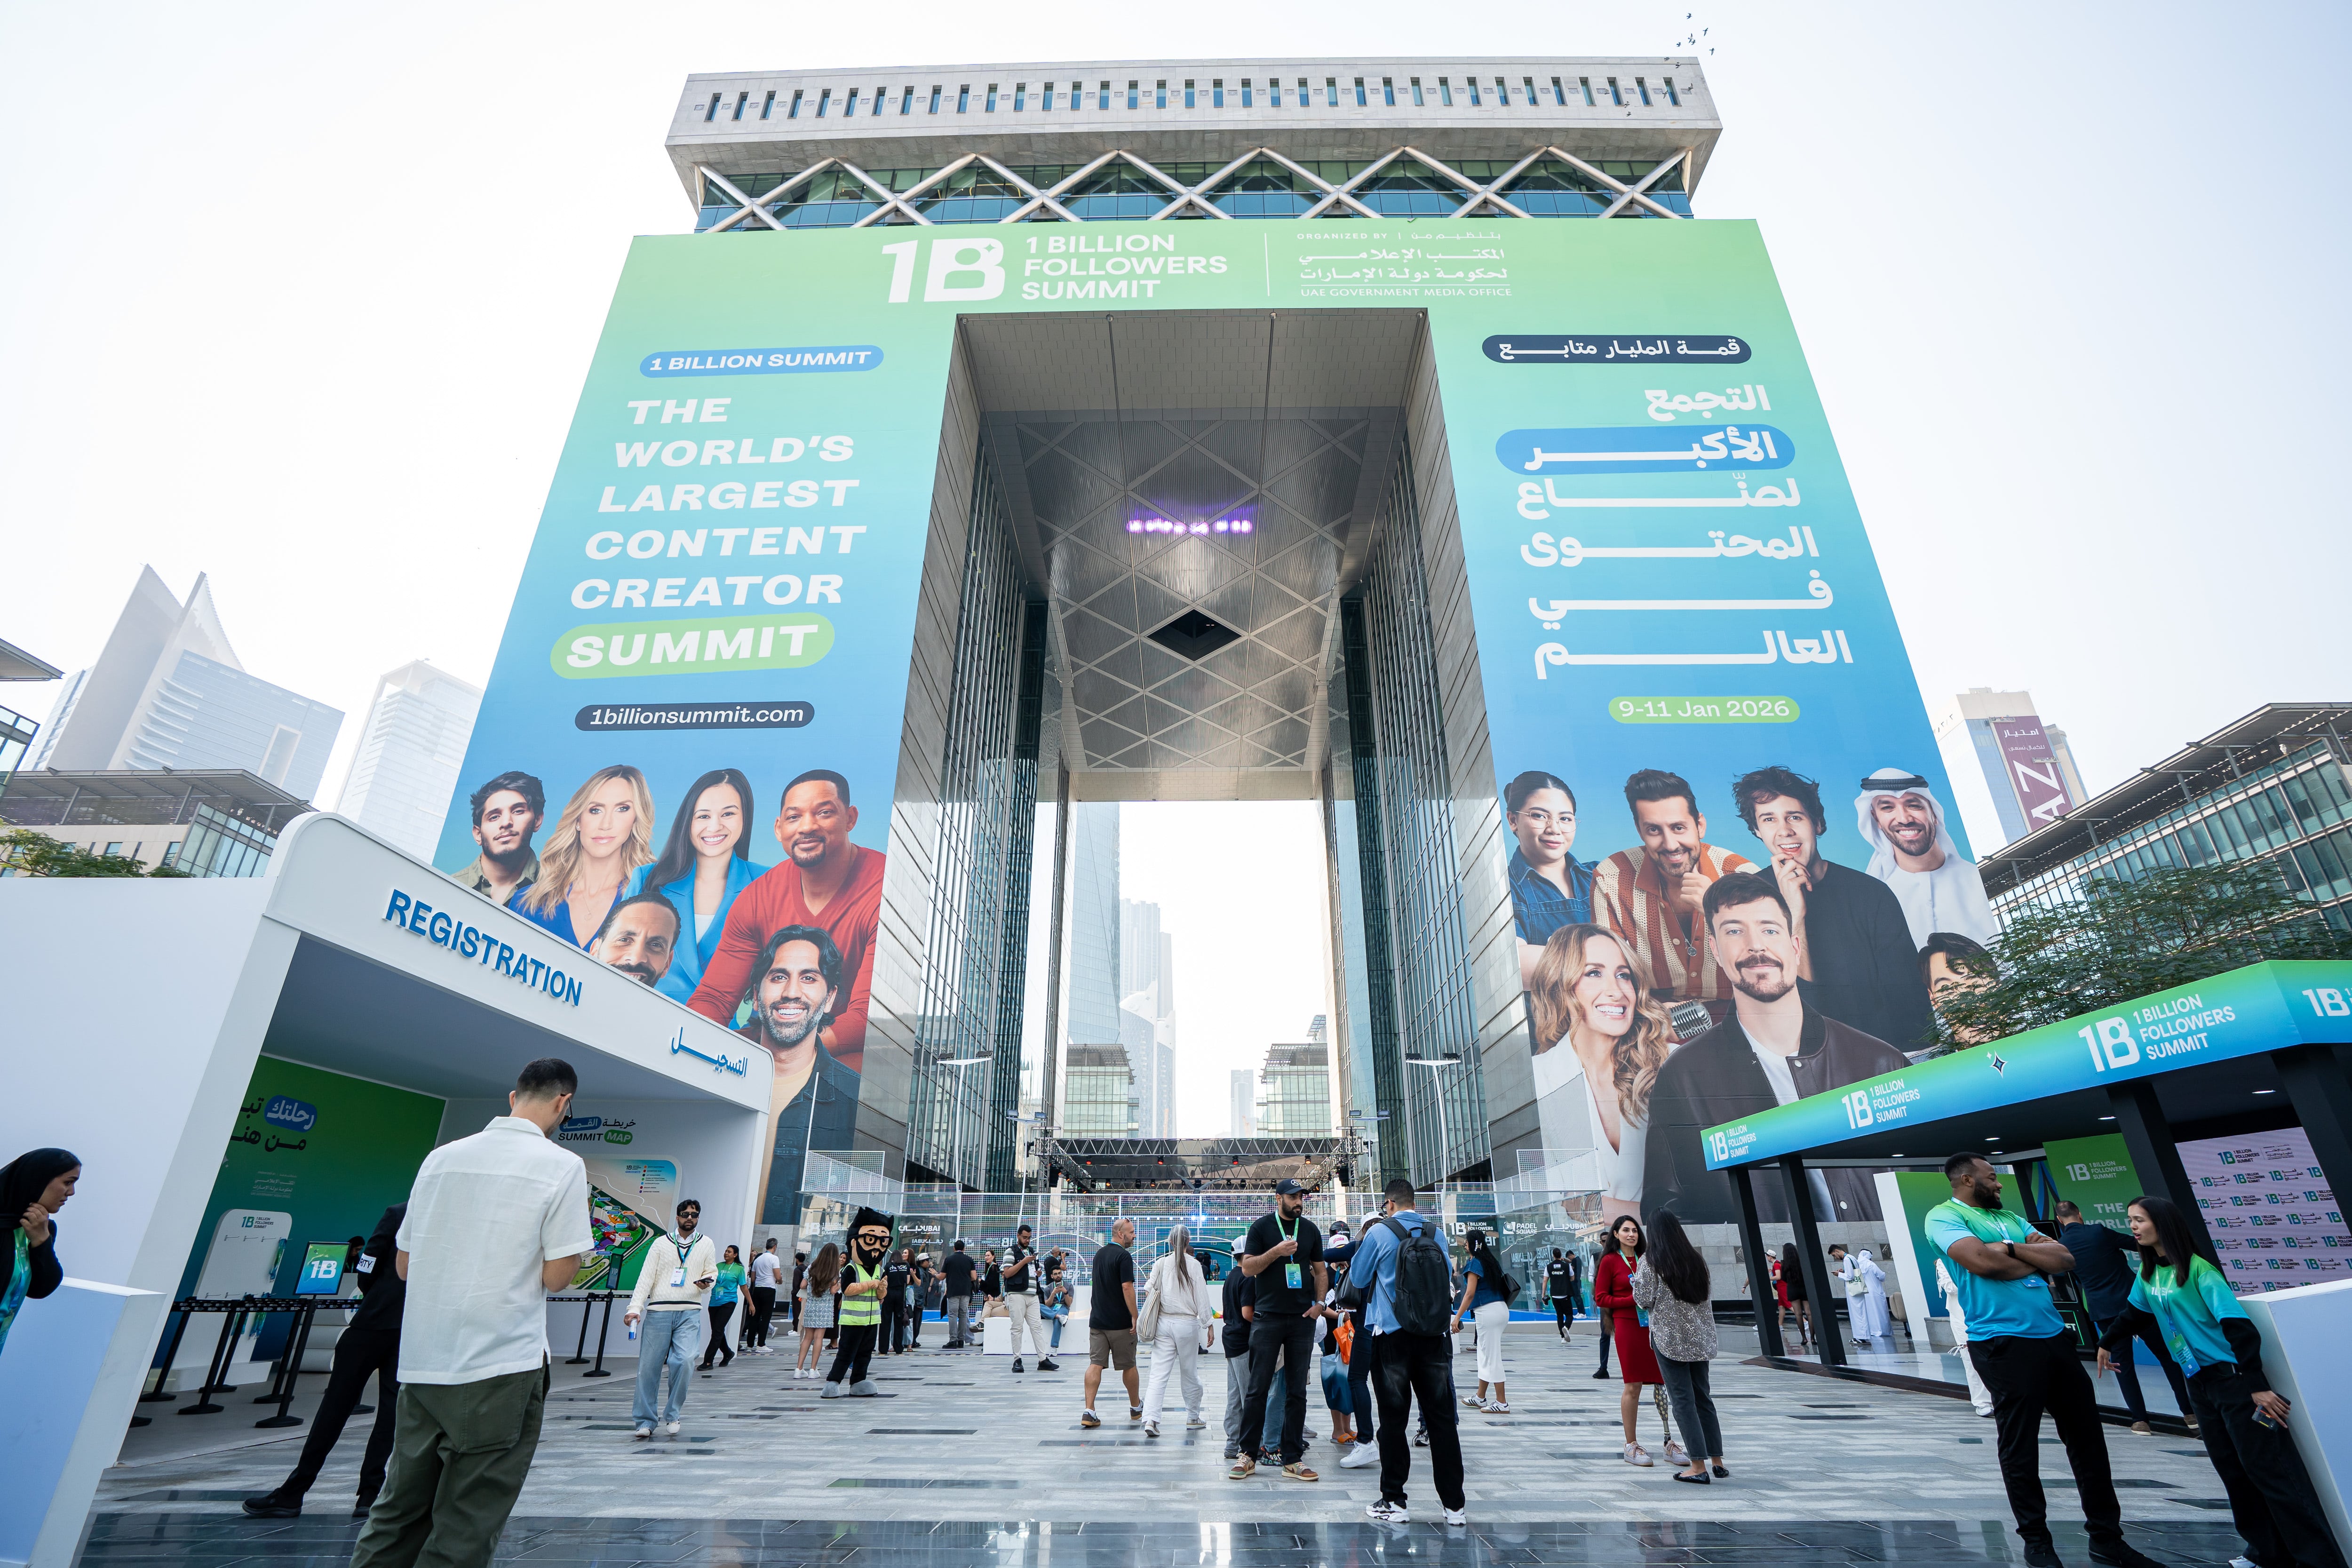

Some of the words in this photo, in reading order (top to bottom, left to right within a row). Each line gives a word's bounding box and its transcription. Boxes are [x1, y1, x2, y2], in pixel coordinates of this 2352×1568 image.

[1026, 236, 1035, 253] 1
[1049, 234, 1174, 253] BILLION
[1299, 248, 1421, 265] الإعلامي
[1426, 248, 1504, 263] المكتب
[882, 238, 1006, 303] 1B
[1025, 256, 1228, 276] FOLLOWERS
[1300, 267, 1383, 282] الإمارات
[1389, 267, 1430, 282] دولة
[1436, 267, 1507, 281] لحكومة
[1022, 280, 1160, 300] SUMMIT
[1330, 288, 1419, 297] GOVERNMENT
[1499, 340, 1597, 359] متابع
[1605, 340, 1670, 359] المليار
[1677, 339, 1740, 356] قمة
[650, 358, 662, 370] 1
[668, 355, 763, 370] BILLION
[768, 351, 872, 366] SUMMIT
[627, 398, 731, 424] THE
[1644, 384, 1772, 422] التجمع
[1524, 426, 1778, 470] الأكبر
[598, 479, 859, 512] LARGEST
[585, 525, 867, 560] CONTENT
[1521, 526, 1820, 567] المحتوى
[571, 574, 843, 609] CREATOR
[1529, 570, 1834, 630] في
[566, 624, 818, 668] SUMMIT
[1534, 630, 1853, 679] العالم
[590, 705, 803, 725] 1billionsummit.com
[1619, 701, 1672, 717] 9-11
[1677, 702, 1721, 717] Jan
[1726, 700, 1789, 717] 2026
[2004, 728, 2039, 738] امتياز
[385, 889, 583, 1006] REGISTRATION
[2133, 1011, 2142, 1025] 1
[2142, 994, 2203, 1023] BILLION
[2302, 988, 2351, 1016] 1B
[2139, 1006, 2236, 1043] FOLLOWERS
[671, 1027, 747, 1078] التسجيل
[2078, 1016, 2140, 1072] 1B
[2145, 1032, 2209, 1060] SUMMIT
[1870, 1087, 1875, 1098] 1
[1875, 1078, 1905, 1096] BILLION
[1873, 1089, 1920, 1110] FOLLOWERS
[267, 1100, 314, 1130] رحلتك
[1842, 1090, 1874, 1130] 1B
[1876, 1106, 1907, 1123] SUMMIT
[603, 1118, 636, 1129] خريطة
[1730, 1124, 1747, 1137] BILLION
[265, 1135, 306, 1152] من
[607, 1132, 631, 1142] MAP
[1728, 1132, 1756, 1147] FOLLOWERS
[1709, 1131, 1729, 1162] 1B
[1730, 1146, 1749, 1158] SUMMIT
[2217, 1151, 2235, 1165] 1B
[2066, 1163, 2090, 1181] 1B
[2233, 1174, 2247, 1184] 1B
[2268, 1170, 2283, 1181] 1B
[2306, 1167, 2323, 1178] 1B
[2200, 1177, 2213, 1186] 1B
[2197, 1199, 2209, 1209] 1B
[2230, 1196, 2243, 1206] 1B
[2265, 1194, 2280, 1204] 1B
[2303, 1191, 2319, 1202] 1B
[2094, 1202, 2125, 1213] THE
[241, 1216, 254, 1228] 1B
[2215, 1218, 2228, 1227] 1B
[2249, 1216, 2263, 1226] 1B
[2286, 1213, 2301, 1225] 1B
[2325, 1212, 2342, 1223] 1B
[805, 1223, 820, 1235] 1B
[1449, 1222, 1466, 1235] 1B
[2212, 1239, 2225, 1250] 1B
[2245, 1238, 2260, 1249] 1B
[2282, 1237, 2297, 1248] 1B
[2321, 1236, 2338, 1247] 1B
[310, 1259, 337, 1279] 1B
[2230, 1259, 2244, 1269] 1B
[2265, 1259, 2280, 1269] 1B
[2304, 1258, 2320, 1269] 1B
[2262, 1281, 2276, 1292] 1B
